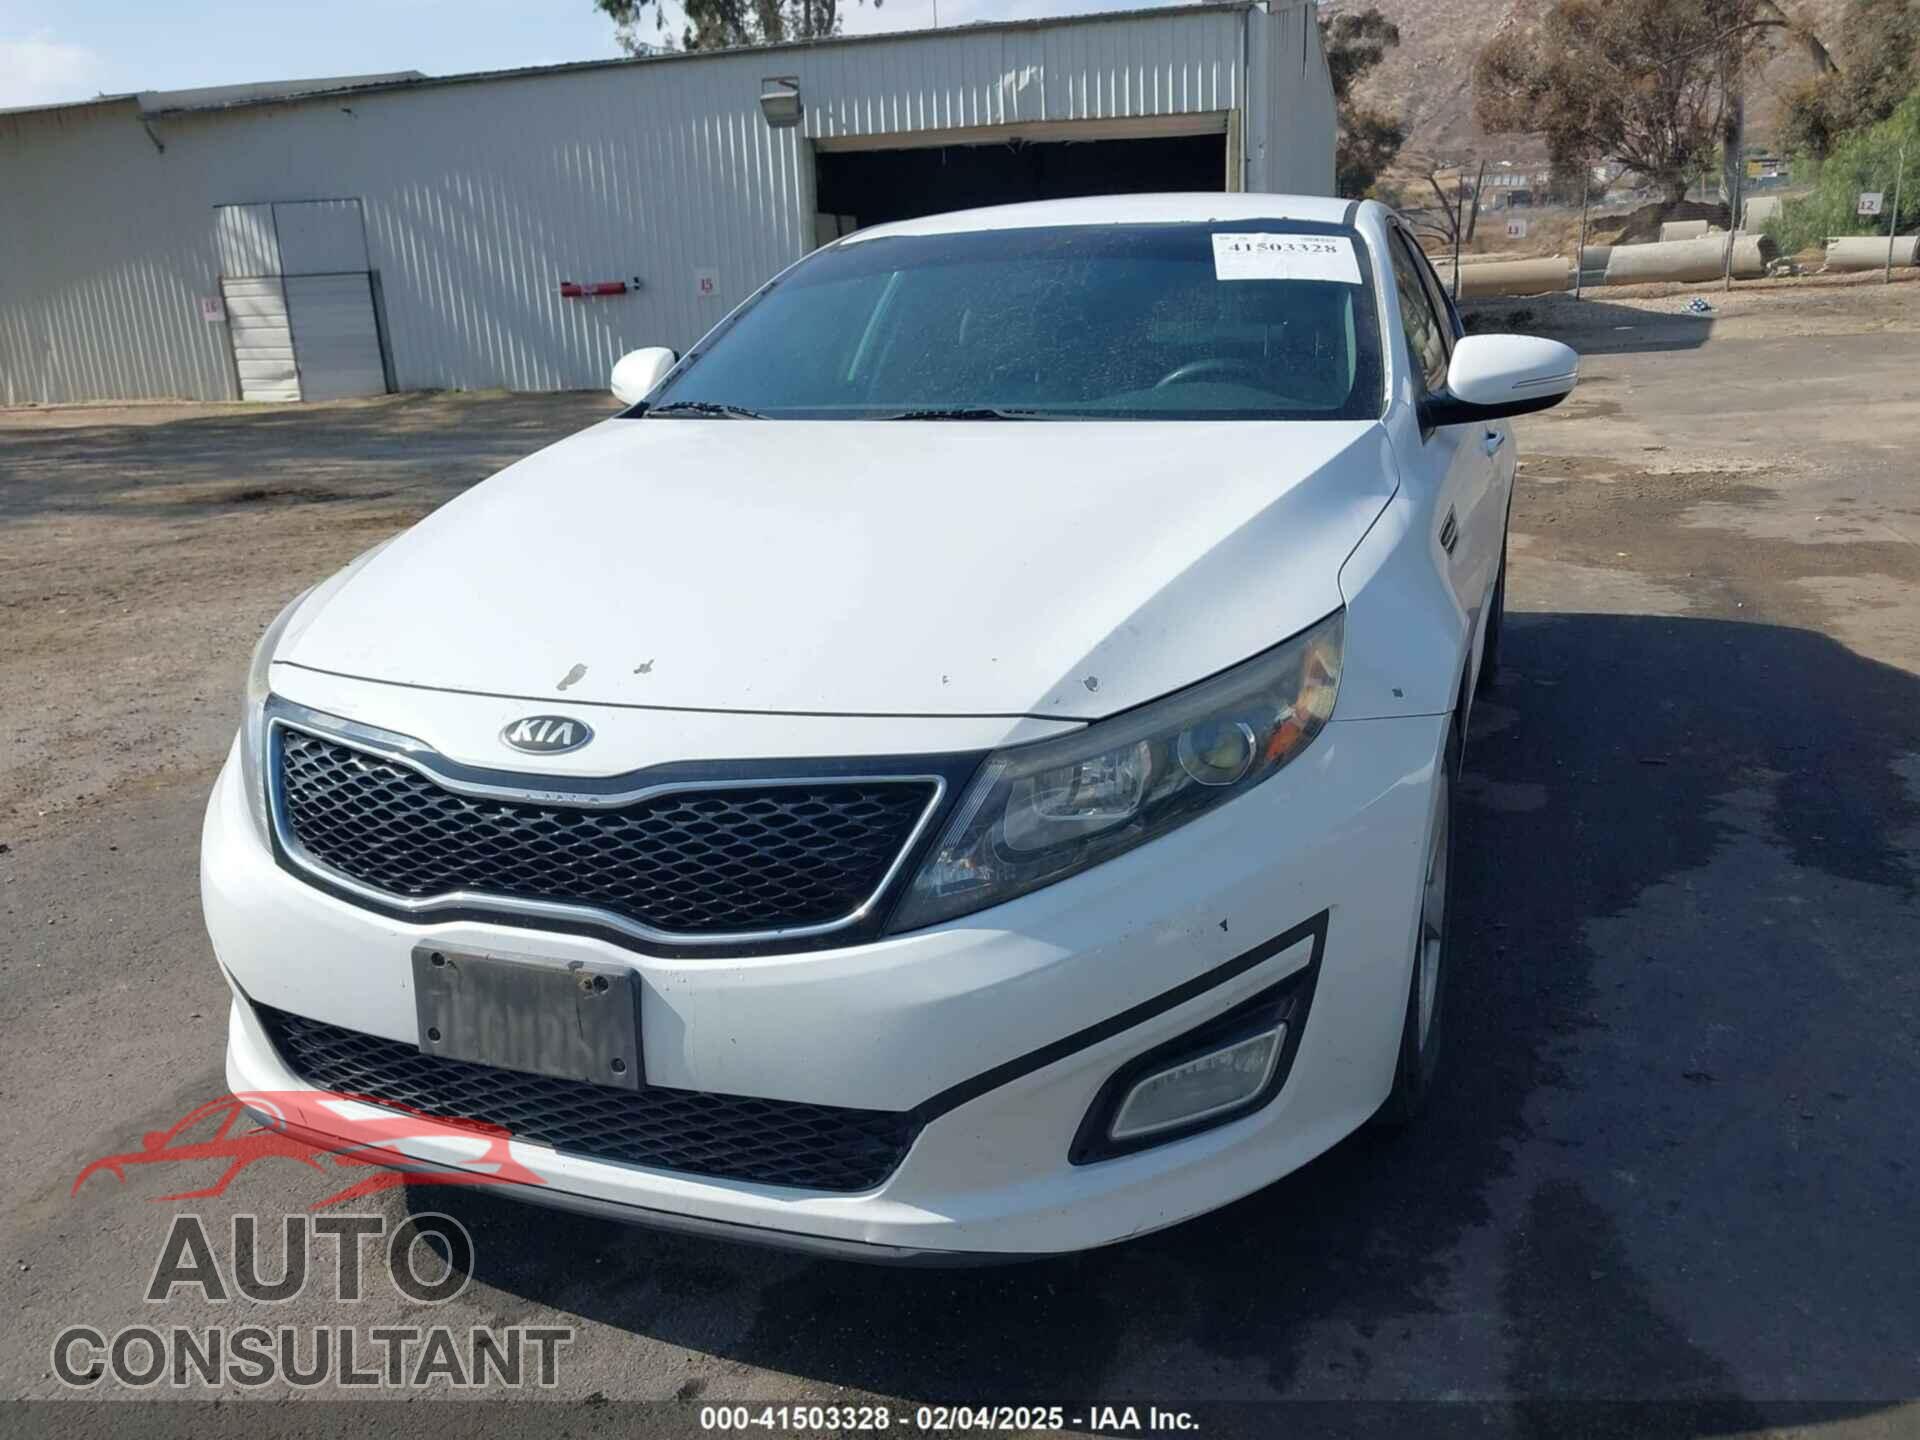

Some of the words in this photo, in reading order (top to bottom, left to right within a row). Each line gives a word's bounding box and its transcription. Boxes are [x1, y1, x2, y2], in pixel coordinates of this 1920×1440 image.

[1229, 242, 1337, 254] 41503328
[701, 277, 713, 294] 15
[509, 719, 575, 745] KIA
